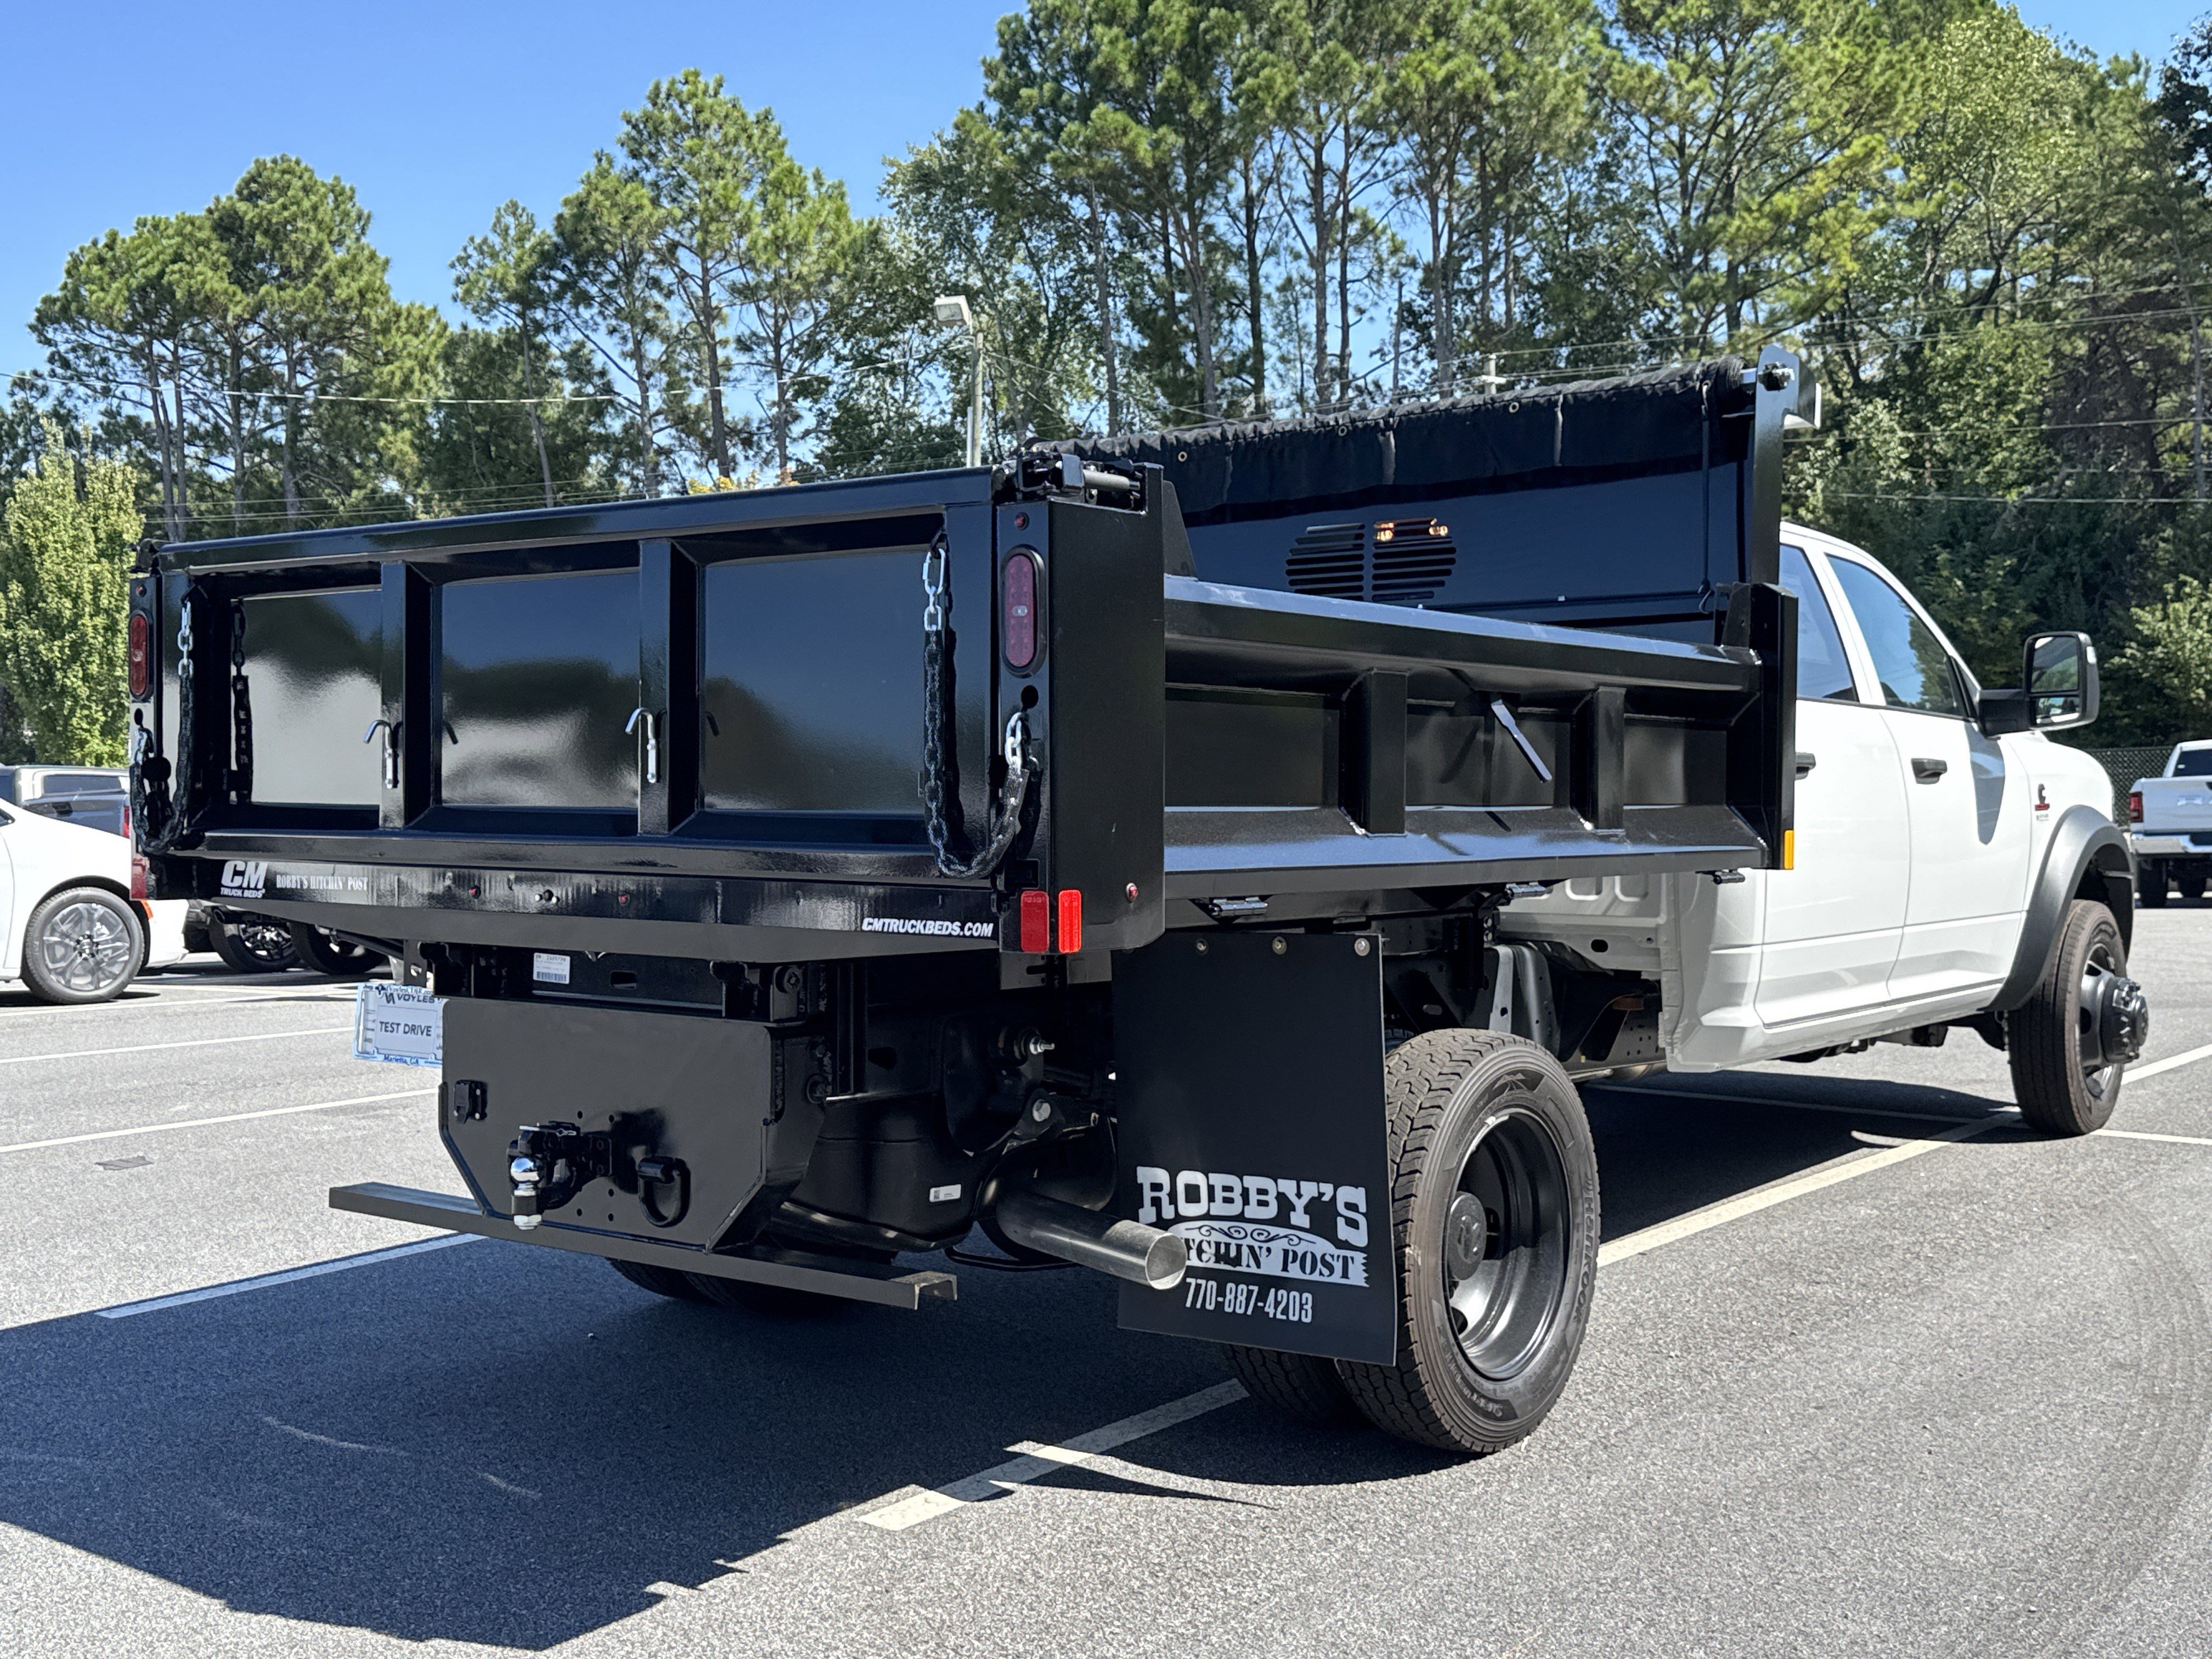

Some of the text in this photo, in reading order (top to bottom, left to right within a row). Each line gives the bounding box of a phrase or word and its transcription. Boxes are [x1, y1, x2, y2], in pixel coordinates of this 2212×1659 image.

[221, 860, 268, 888] CM
[276, 874, 308, 889] ROBBY'S
[347, 876, 368, 891] POST
[221, 887, 242, 897] TRUCK
[862, 917, 994, 937] CMTRUCKBEDS.COM
[397, 993, 435, 1003] VOYLES
[379, 1021, 432, 1037] TEST DRIVE
[1137, 1166, 1368, 1247] ROBBY'S
[1280, 1248, 1355, 1280] POST
[1185, 1277, 1313, 1323] 770-887-4203
